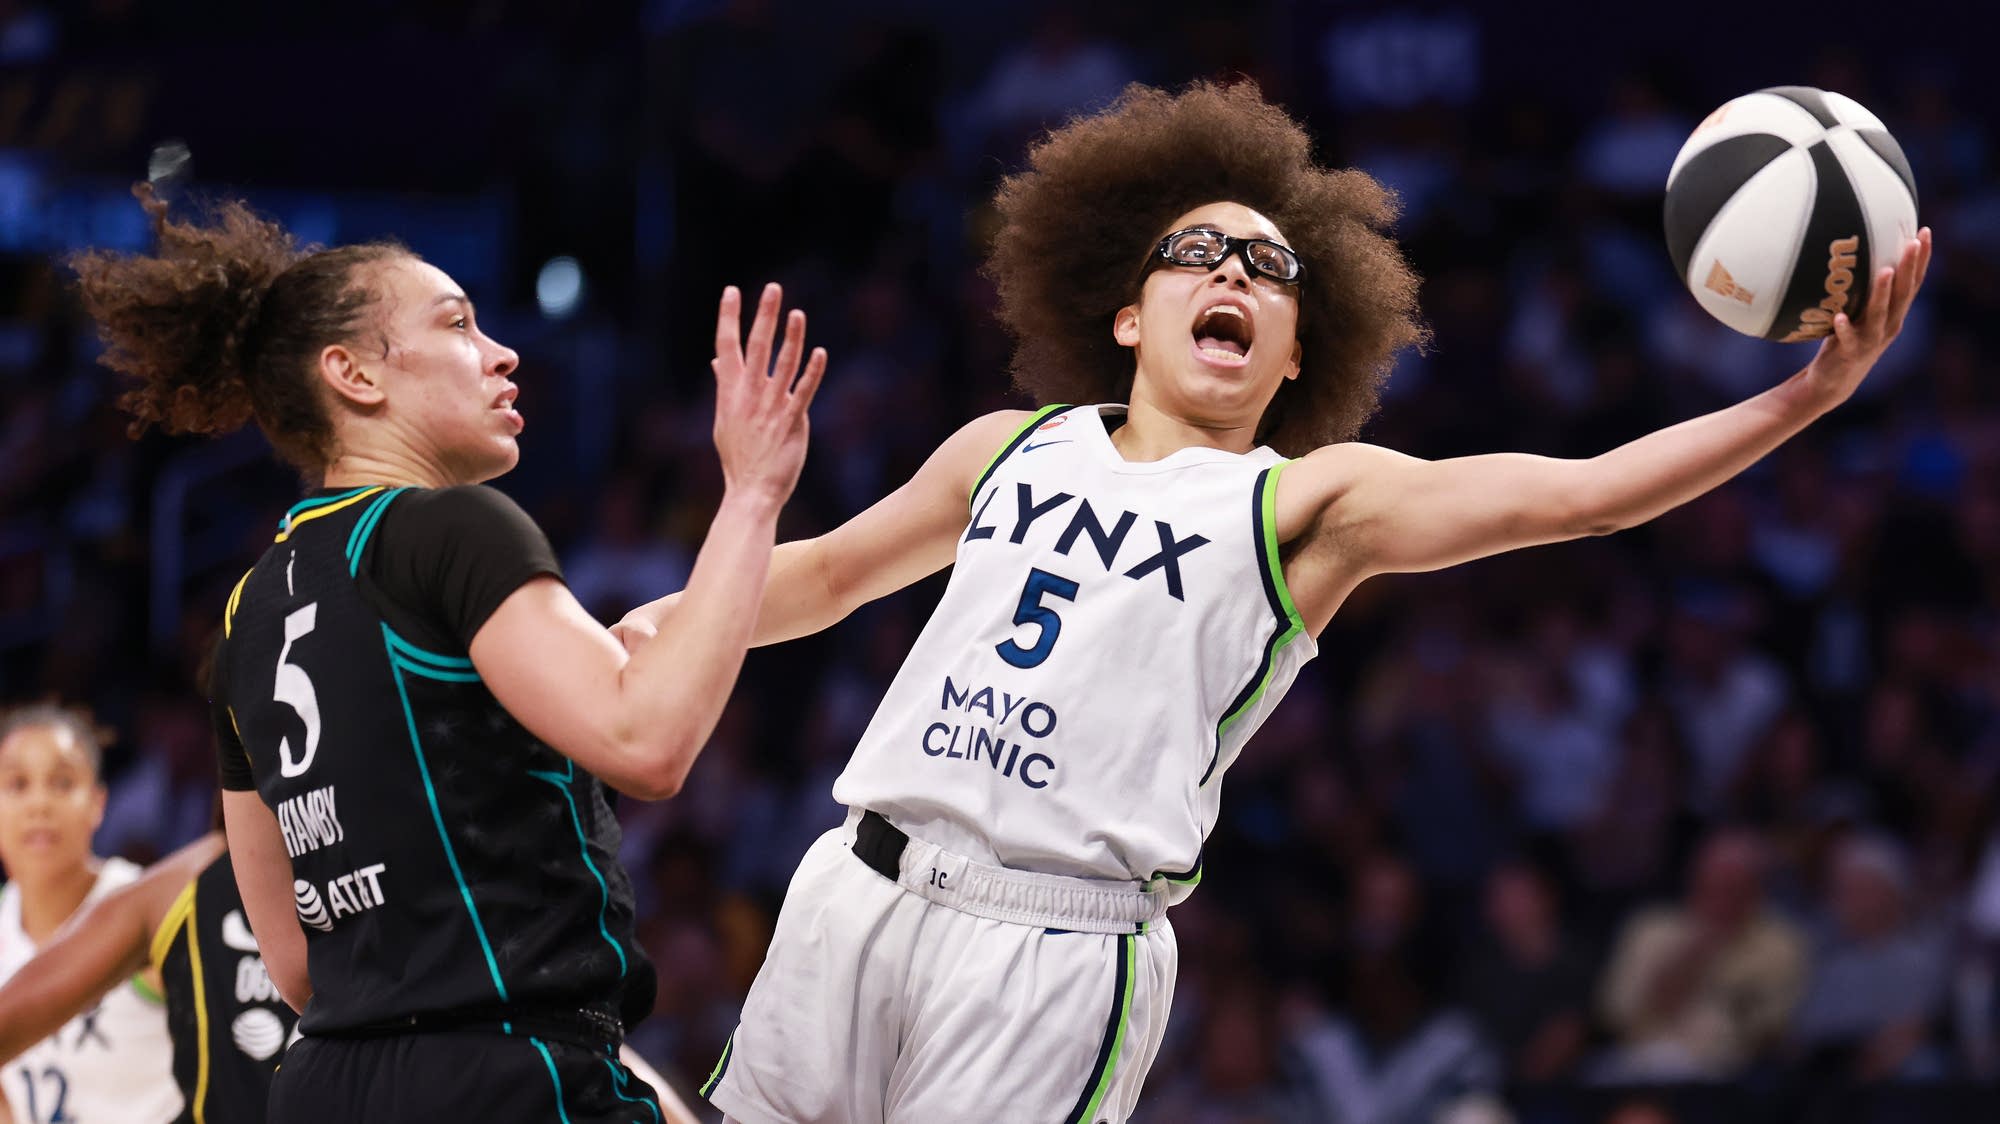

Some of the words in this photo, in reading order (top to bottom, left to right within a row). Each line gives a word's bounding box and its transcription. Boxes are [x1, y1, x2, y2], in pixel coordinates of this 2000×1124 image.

[963, 482, 1212, 602] LYNX
[995, 567, 1080, 669] 5
[273, 601, 321, 778] 5
[941, 675, 1057, 738] MAYO
[921, 722, 1056, 789] CLINIC
[278, 785, 344, 858] HAMBY
[327, 863, 386, 919] AT&T
[20, 1064, 78, 1124] 12
